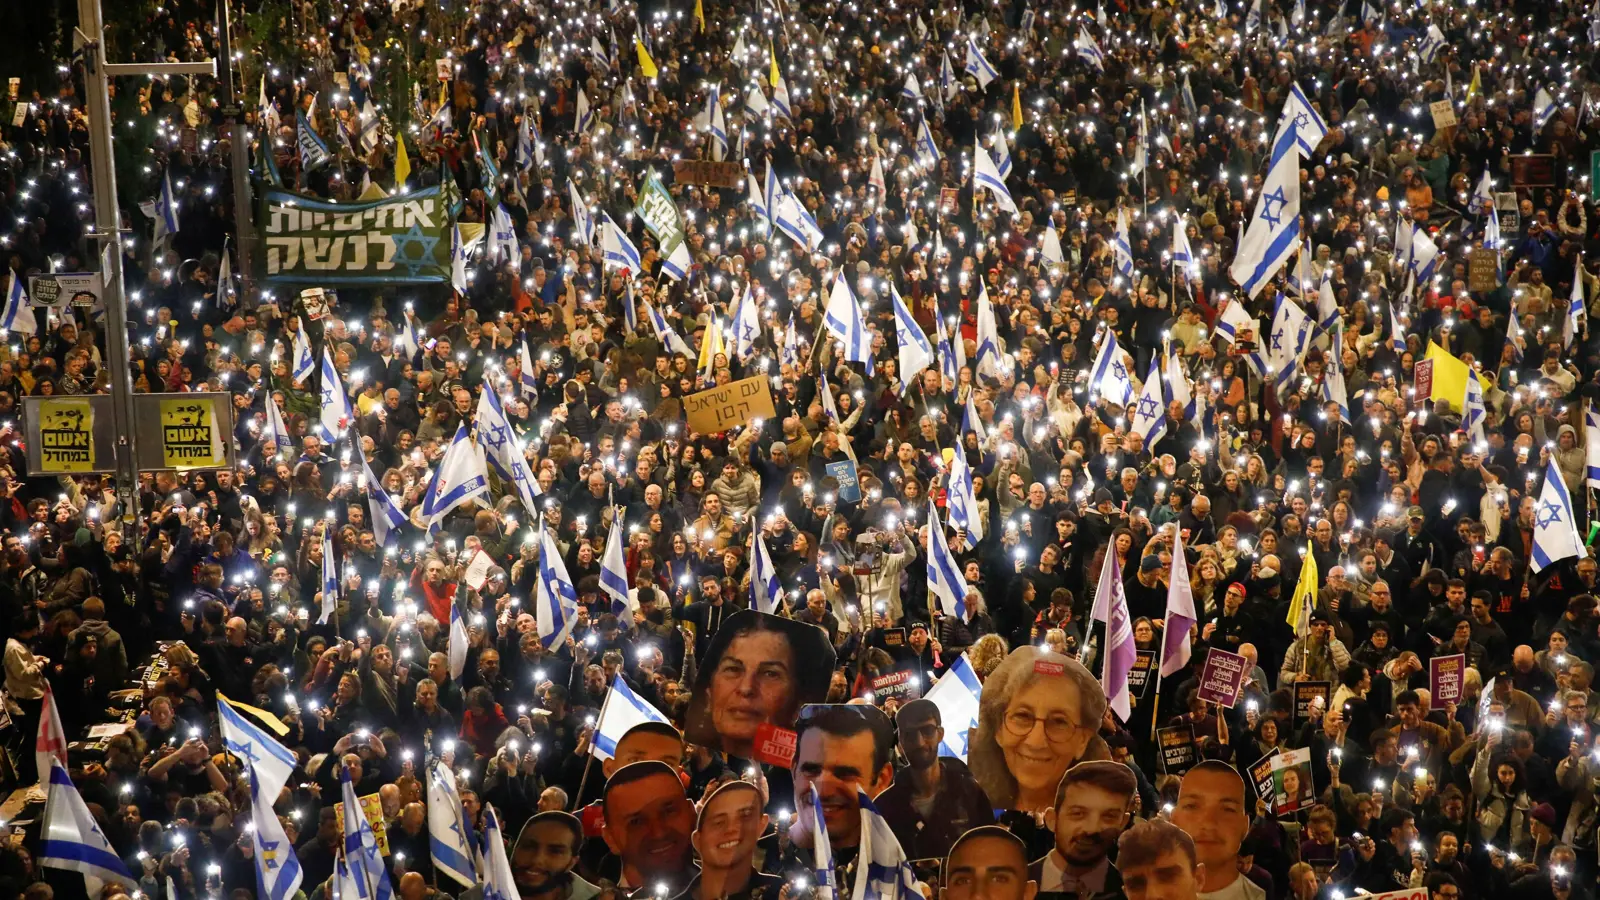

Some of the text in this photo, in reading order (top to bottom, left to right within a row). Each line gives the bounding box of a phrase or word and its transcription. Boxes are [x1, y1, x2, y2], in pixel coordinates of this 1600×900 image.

[266, 231, 397, 274] לנשק
[688, 380, 760, 412] עם ישראל
[43, 432, 88, 447] אשם
[165, 428, 209, 443] אשם
[43, 448, 90, 463] במחדל
[165, 445, 212, 458] במחדל
[874, 671, 909, 688] די למלחמה
[1214, 672, 1231, 681] מאבק
[894, 682, 911, 692] סקה
[773, 729, 796, 745] דיין
[764, 742, 792, 758] עזה.
